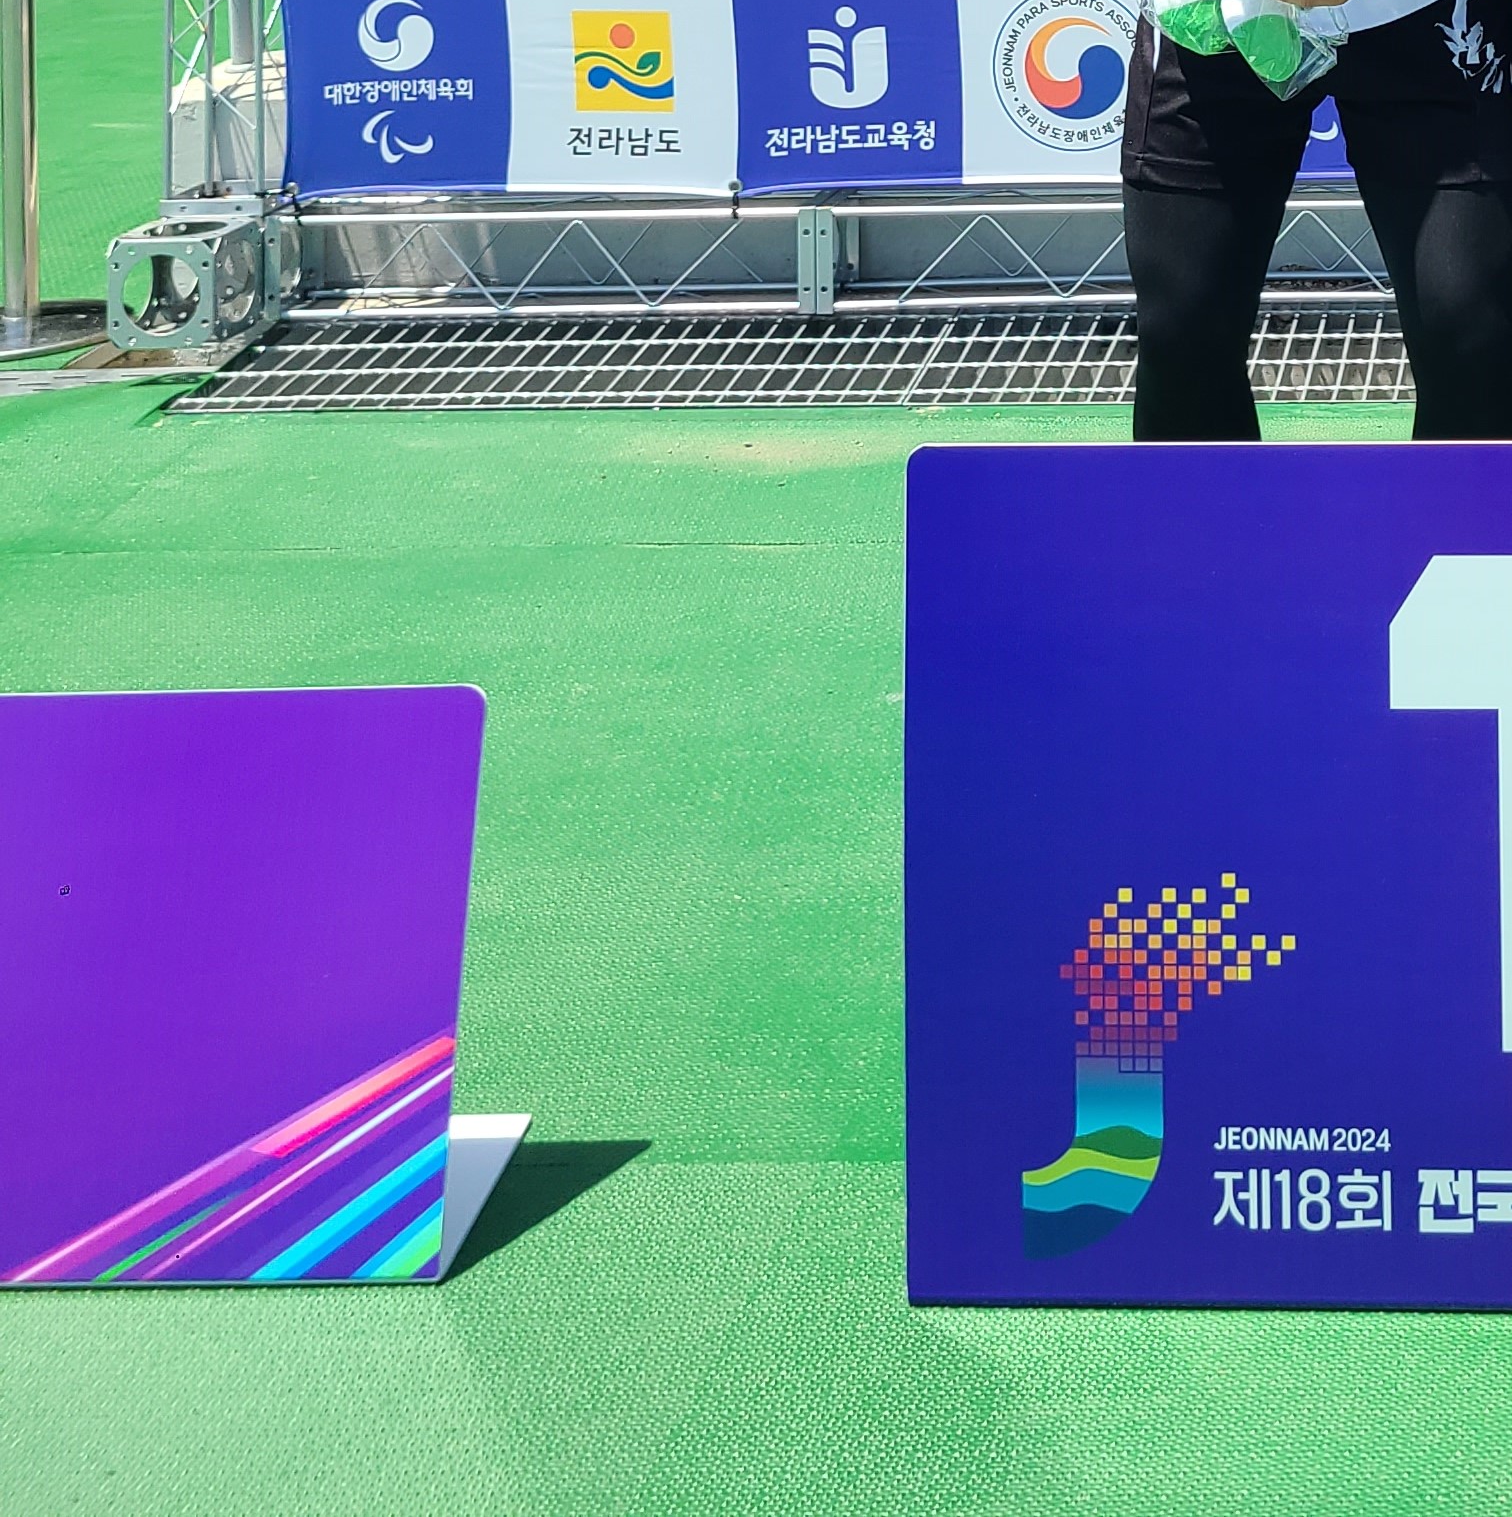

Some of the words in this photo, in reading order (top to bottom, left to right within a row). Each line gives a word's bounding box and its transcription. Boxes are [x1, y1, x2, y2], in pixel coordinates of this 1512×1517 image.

[1003, 29, 1021, 92] JEONNAM
[1017, 3, 1048, 29] PARA
[325, 79, 472, 104] 대한장애인체육회
[766, 121, 935, 156] 전라남도교육청
[1017, 103, 1126, 143] 전라남도장애인체육
[568, 128, 680, 156] 전라남도
[1214, 1169, 1391, 1230] 제18회
